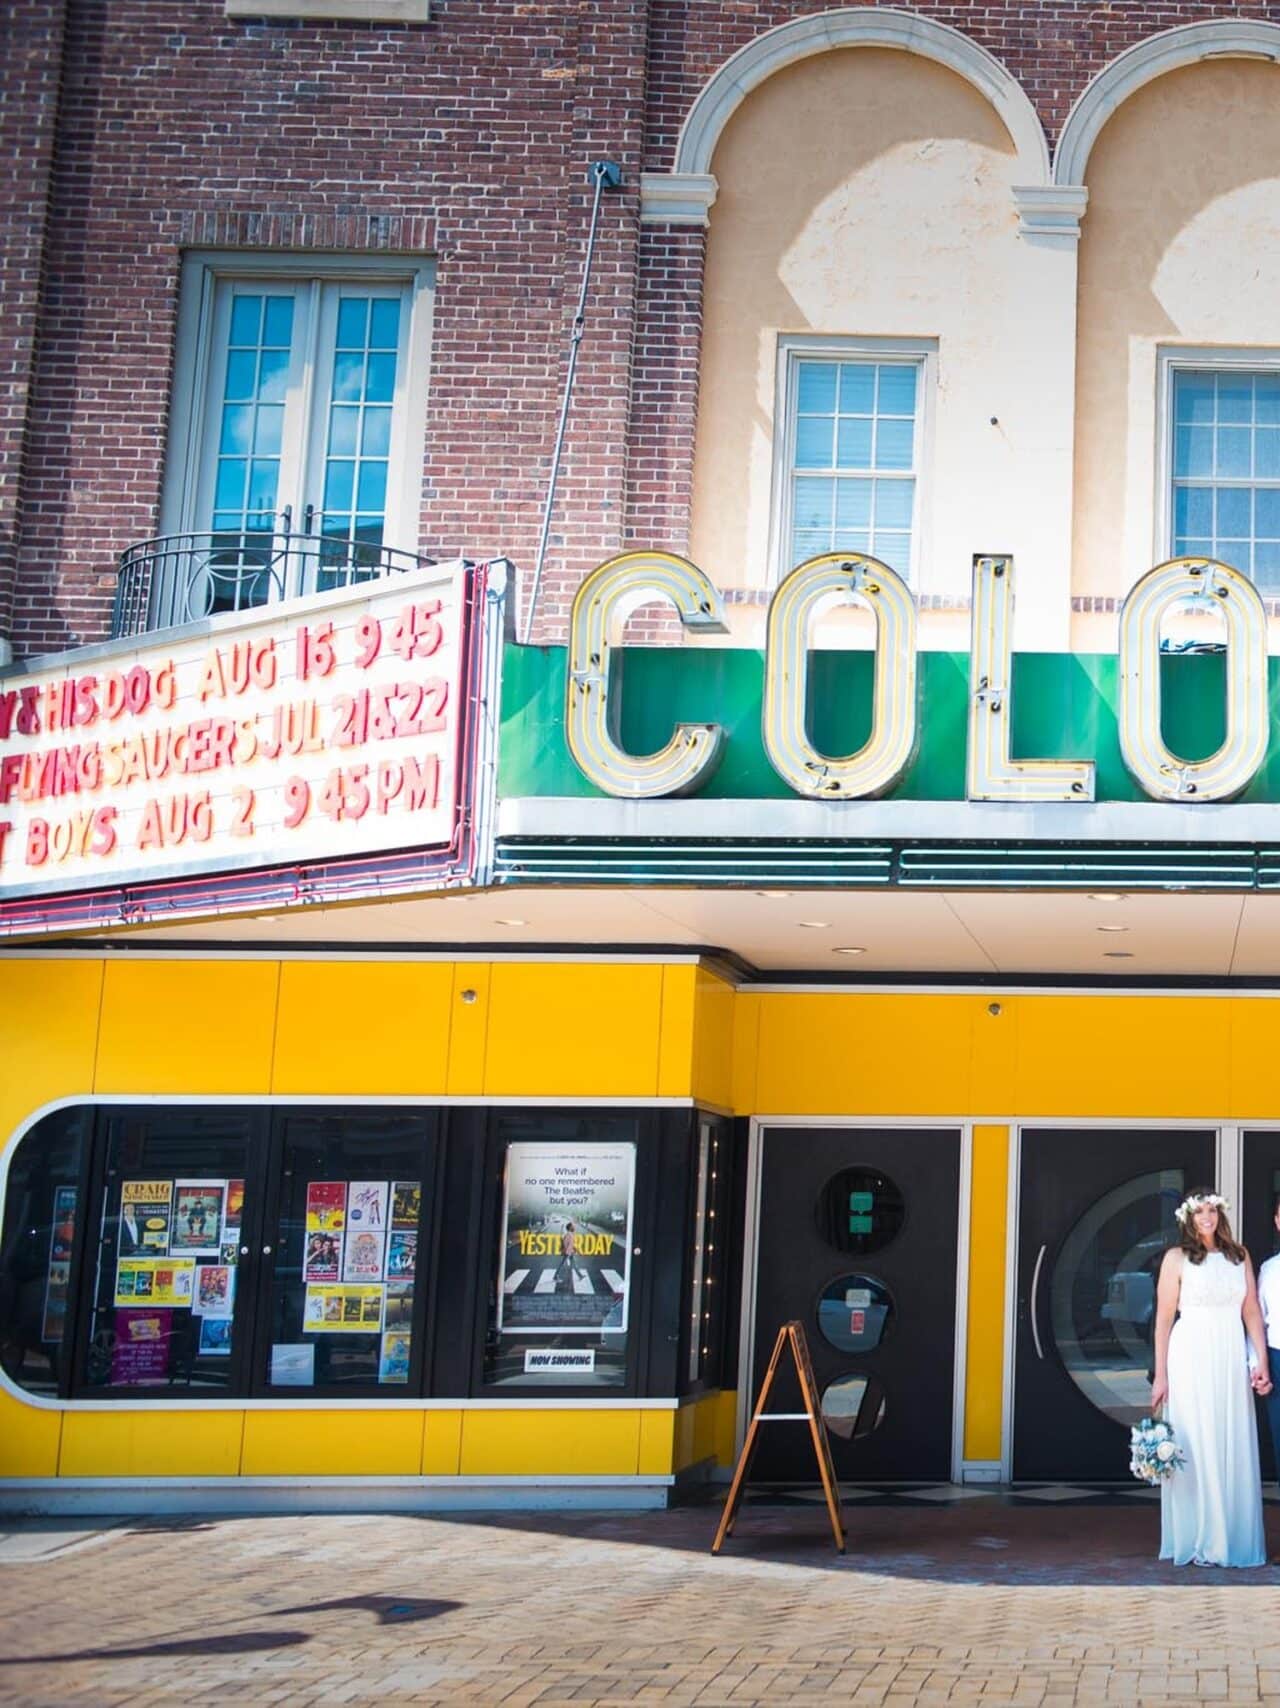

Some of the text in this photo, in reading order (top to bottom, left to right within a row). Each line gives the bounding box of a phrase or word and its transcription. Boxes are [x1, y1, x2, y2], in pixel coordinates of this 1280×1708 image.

[103, 657, 177, 721] DOG
[202, 636, 277, 702] AUG
[296, 621, 336, 681] 16
[354, 614, 382, 669] 9
[388, 599, 443, 661] 45
[0, 741, 101, 804] FLYING
[104, 712, 259, 788] SAUCERS
[261, 698, 325, 761] JUL
[25, 804, 117, 867] BOYS
[137, 789, 213, 852] AUG
[229, 783, 257, 838] 2
[284, 775, 311, 829] 9
[554, 1167, 588, 1176] What if
[525, 1177, 615, 1186] no one remembered
[545, 1186, 595, 1195] The Beatles
[549, 1196, 589, 1206] but you?
[529, 1355, 592, 1365] NOW SHOWING
